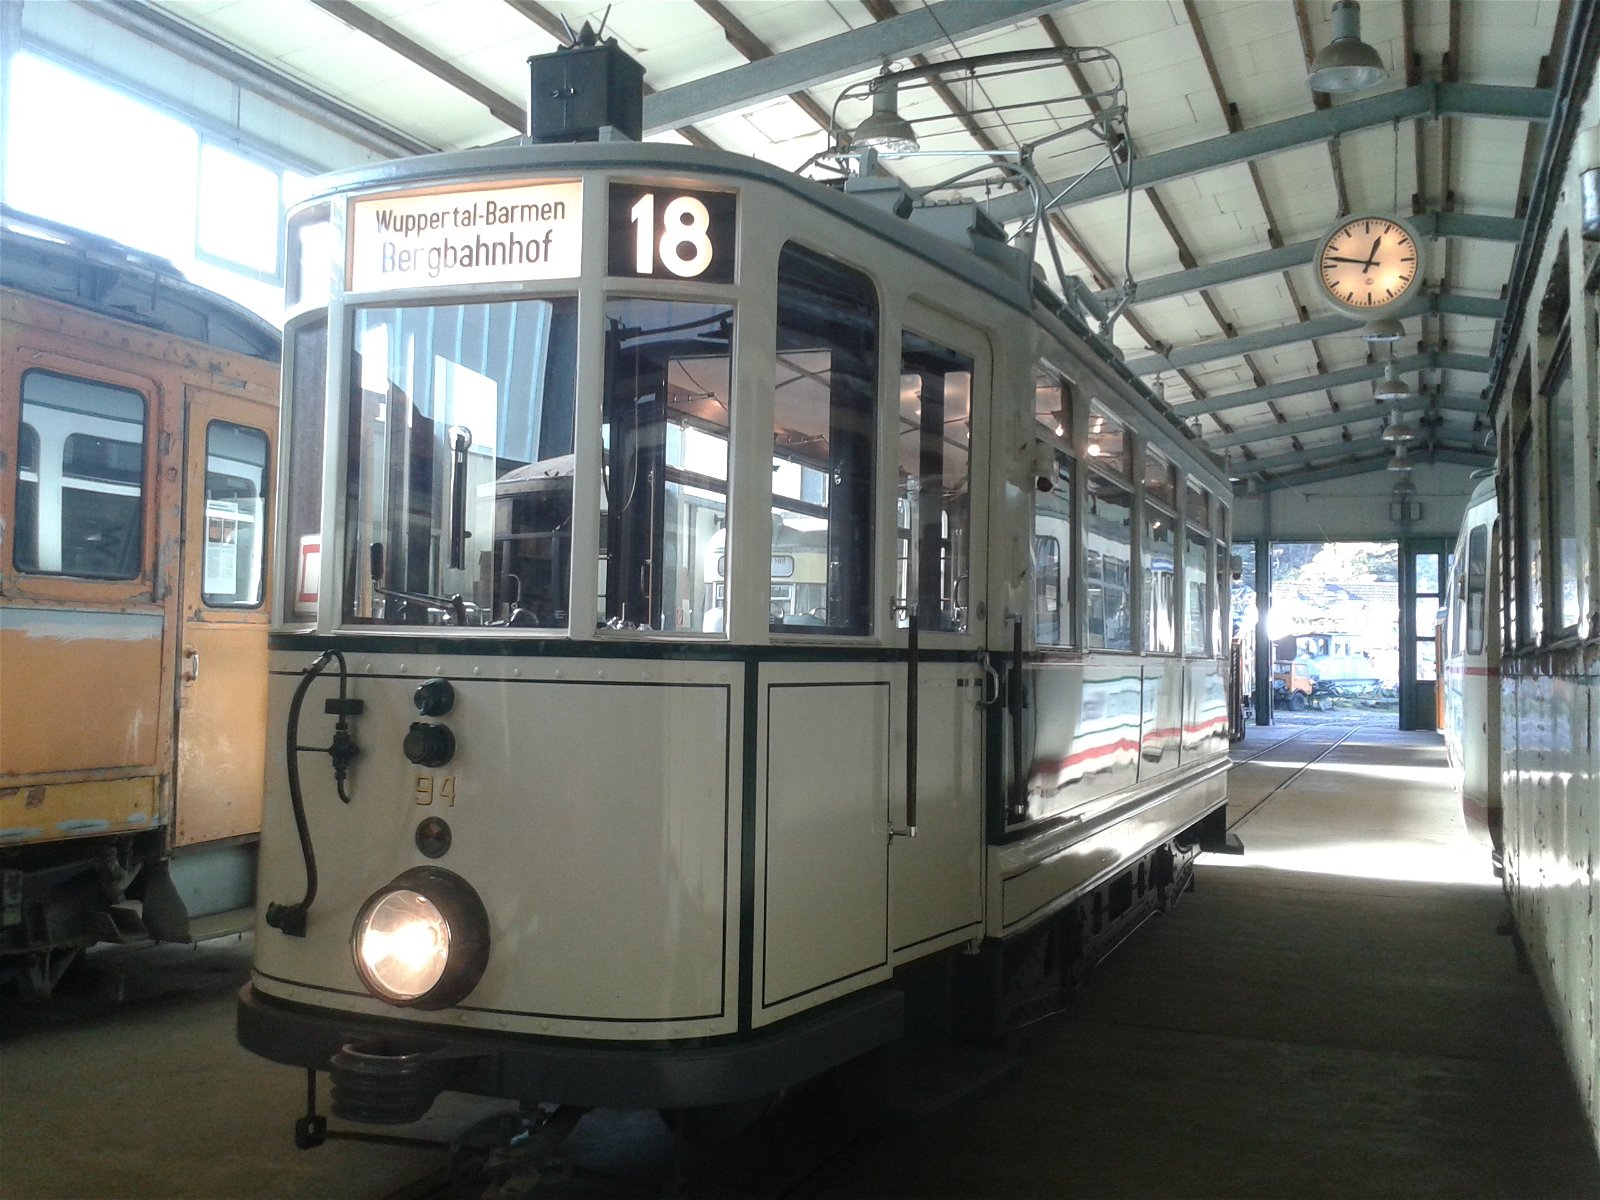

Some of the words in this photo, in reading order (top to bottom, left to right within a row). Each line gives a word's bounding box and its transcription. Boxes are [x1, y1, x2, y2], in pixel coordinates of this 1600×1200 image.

[376, 201, 566, 238] Wuppertal-Barmen
[631, 193, 713, 278] 18
[382, 229, 553, 278] Bergbahnhof
[415, 775, 456, 807] 94
